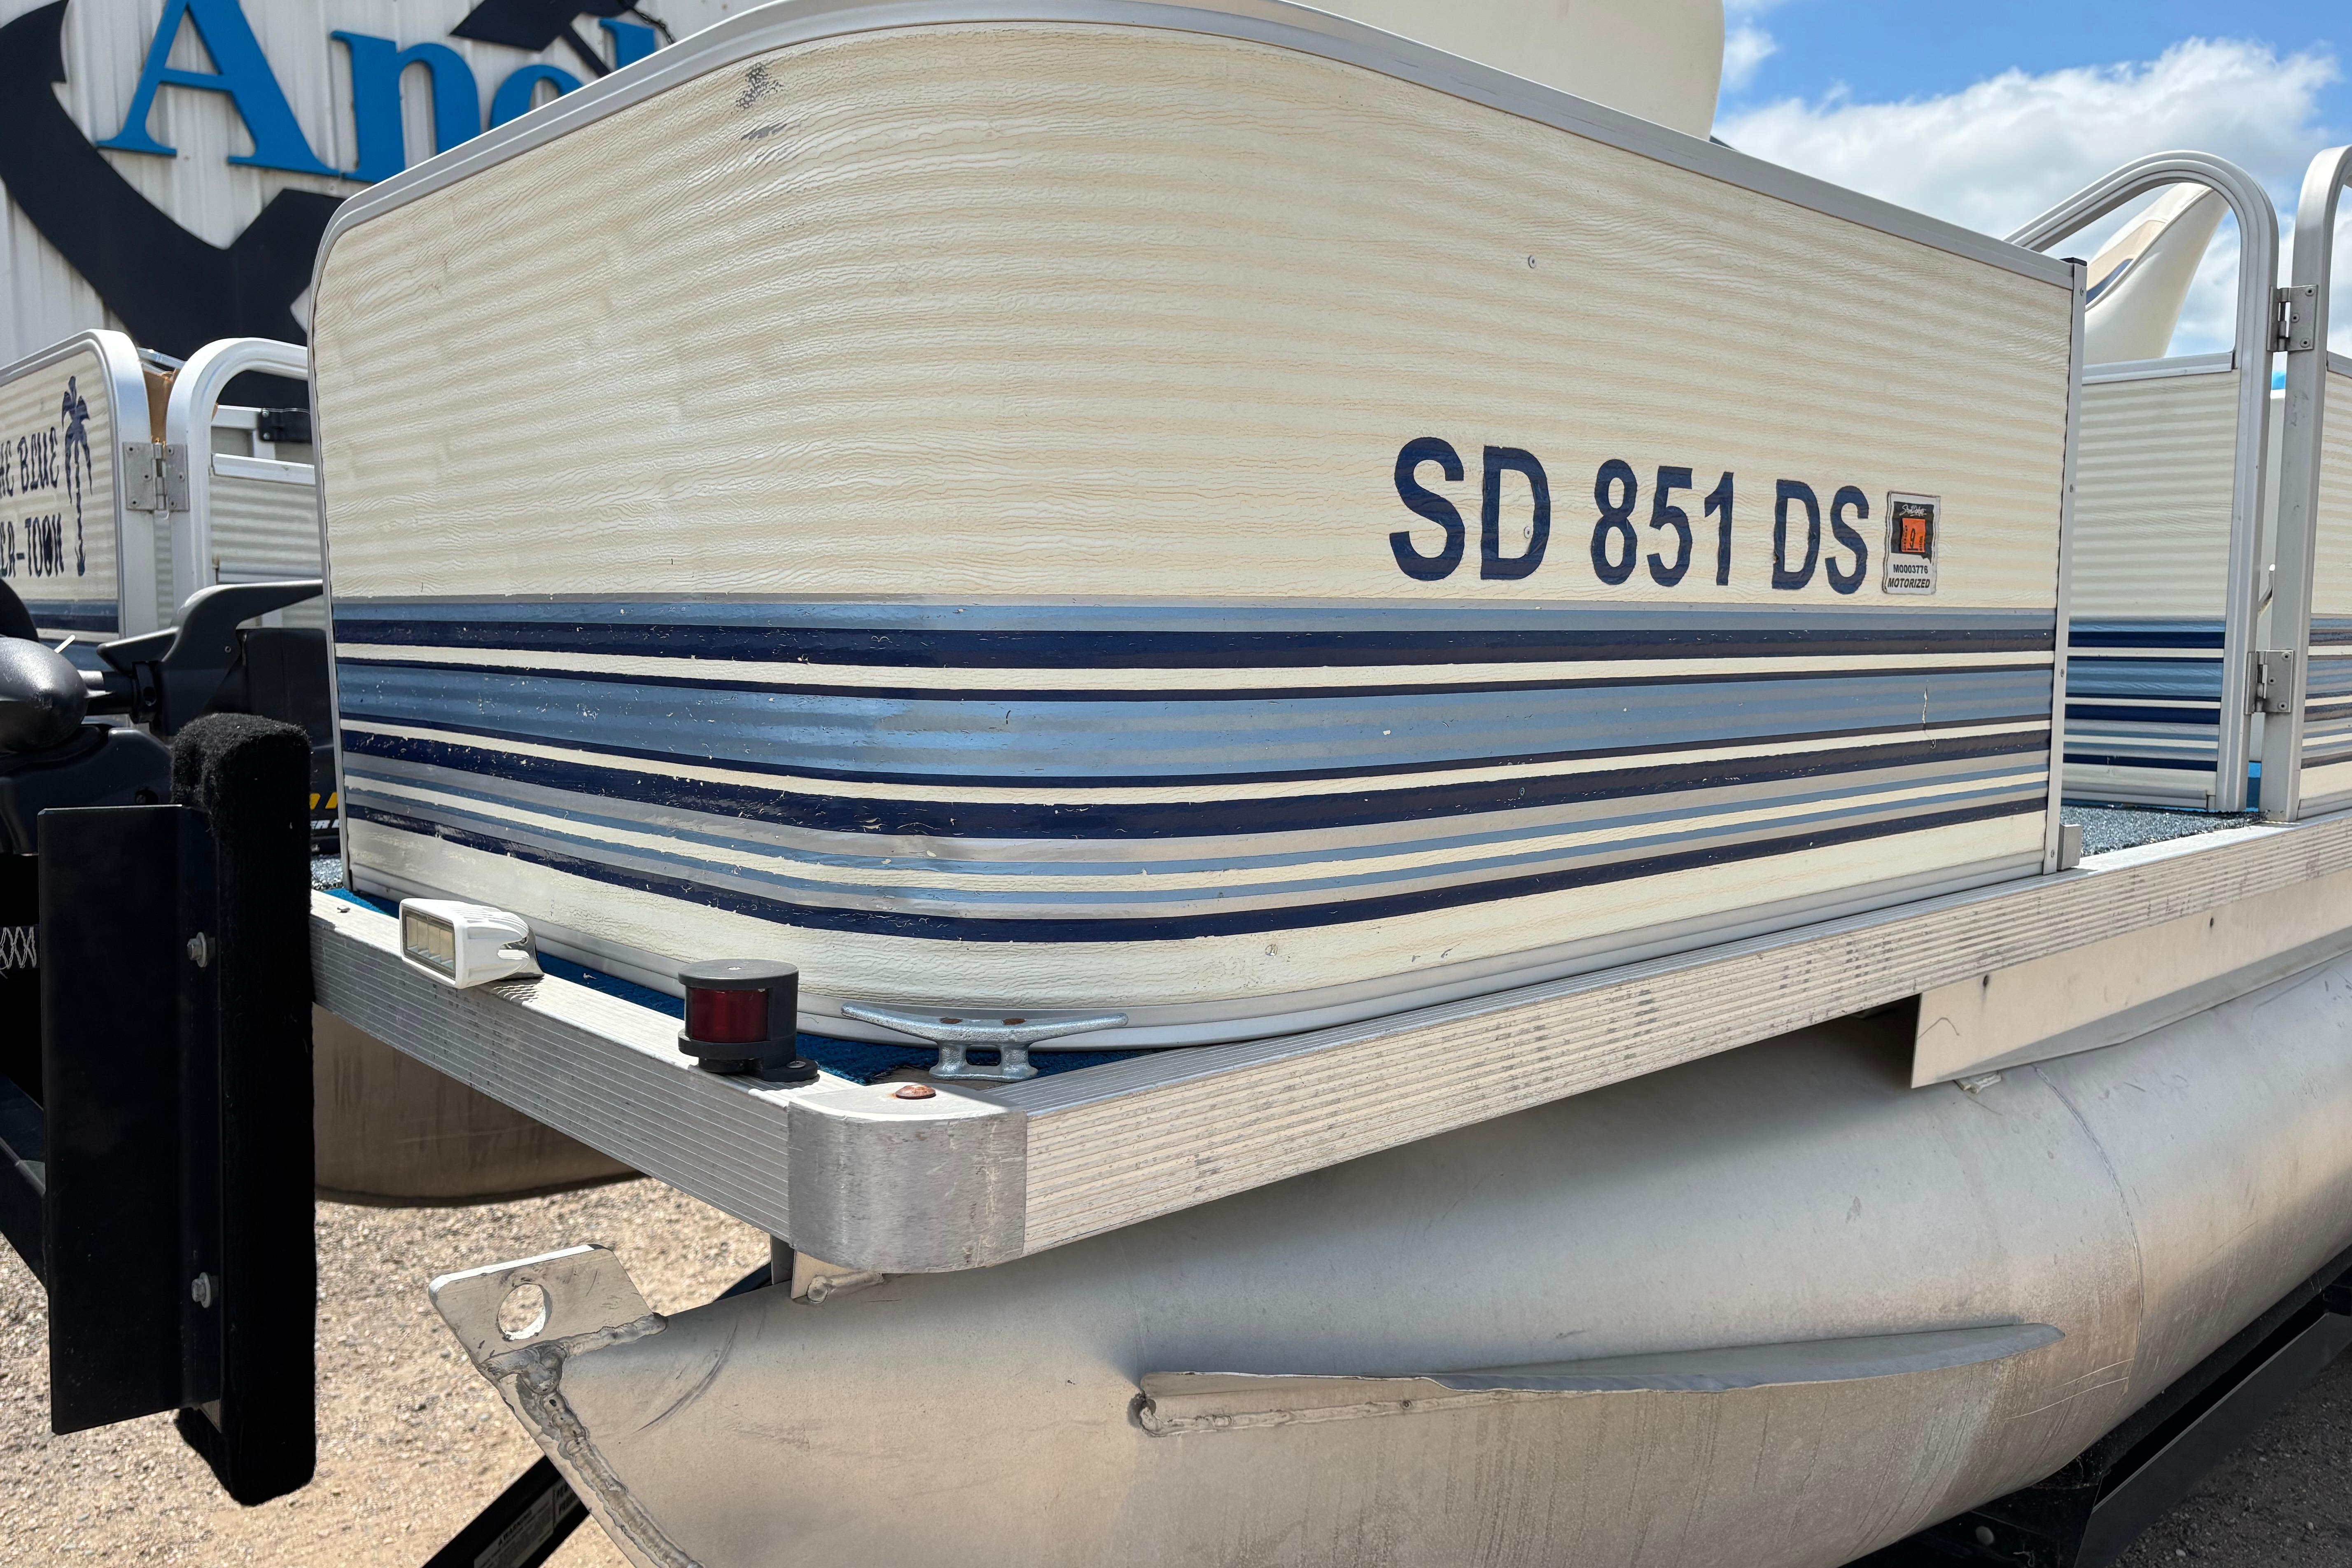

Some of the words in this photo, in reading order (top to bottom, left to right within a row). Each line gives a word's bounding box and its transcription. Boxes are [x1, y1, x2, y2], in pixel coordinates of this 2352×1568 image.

[97, 0, 656, 183] An
[18, 426, 59, 494] BLUE
[1389, 437, 1551, 581] SD
[1591, 459, 1734, 587] 851
[1772, 479, 1869, 595] DS
[1888, 578, 1930, 588] MOTORIZED
